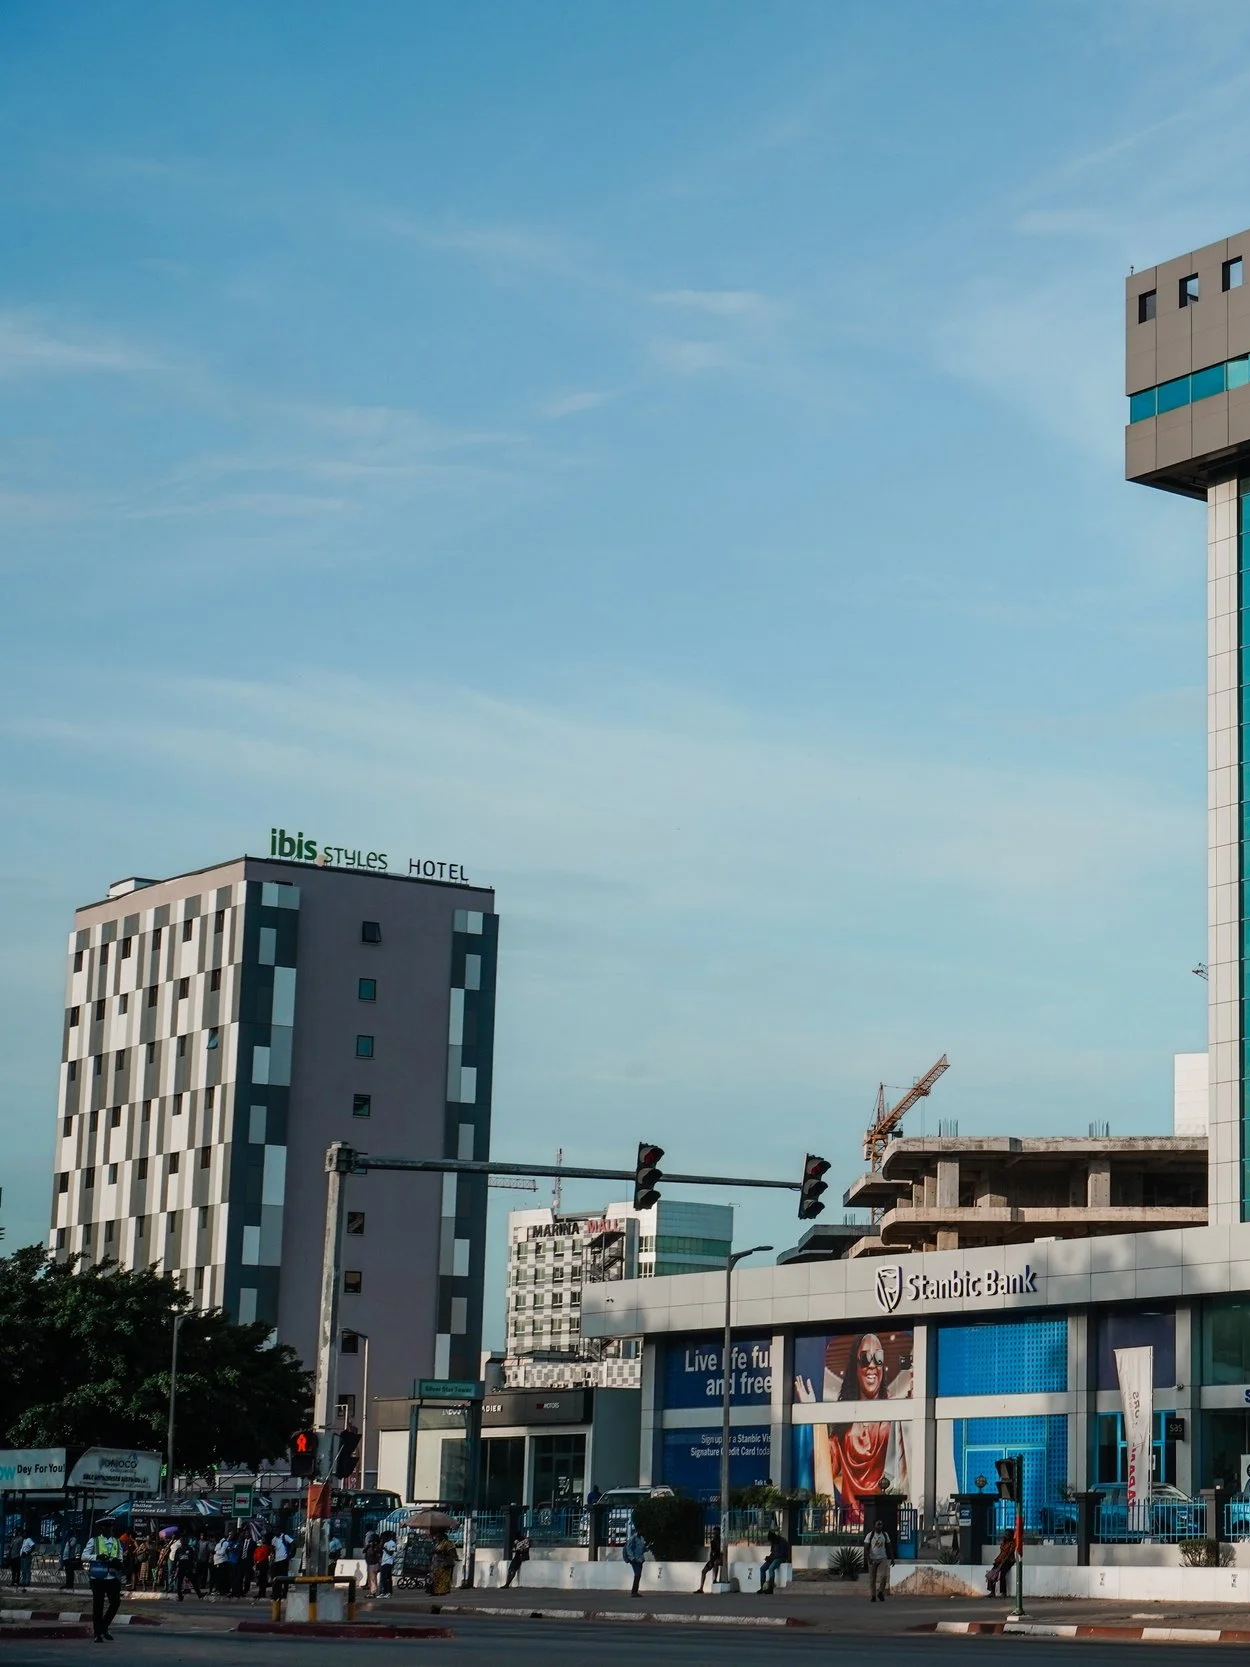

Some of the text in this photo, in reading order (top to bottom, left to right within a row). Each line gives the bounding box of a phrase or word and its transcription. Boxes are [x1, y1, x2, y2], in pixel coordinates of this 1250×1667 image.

[271, 828, 317, 861] ibis
[409, 858, 469, 881] HOTEL
[532, 1219, 620, 1238] MARINA MALL
[906, 1264, 1038, 1301] Stanbic Bank
[685, 1350, 717, 1372] Live
[722, 1347, 747, 1370] lfe
[741, 1372, 773, 1395] free
[1169, 1423, 1183, 1433] sas
[701, 1434, 715, 1446] Sign
[737, 1434, 761, 1443] Stanbic
[690, 1447, 720, 1458] Signature
[741, 1446, 756, 1455] Card
[17, 1464, 32, 1475] Dey
[34, 1463, 48, 1473] For
